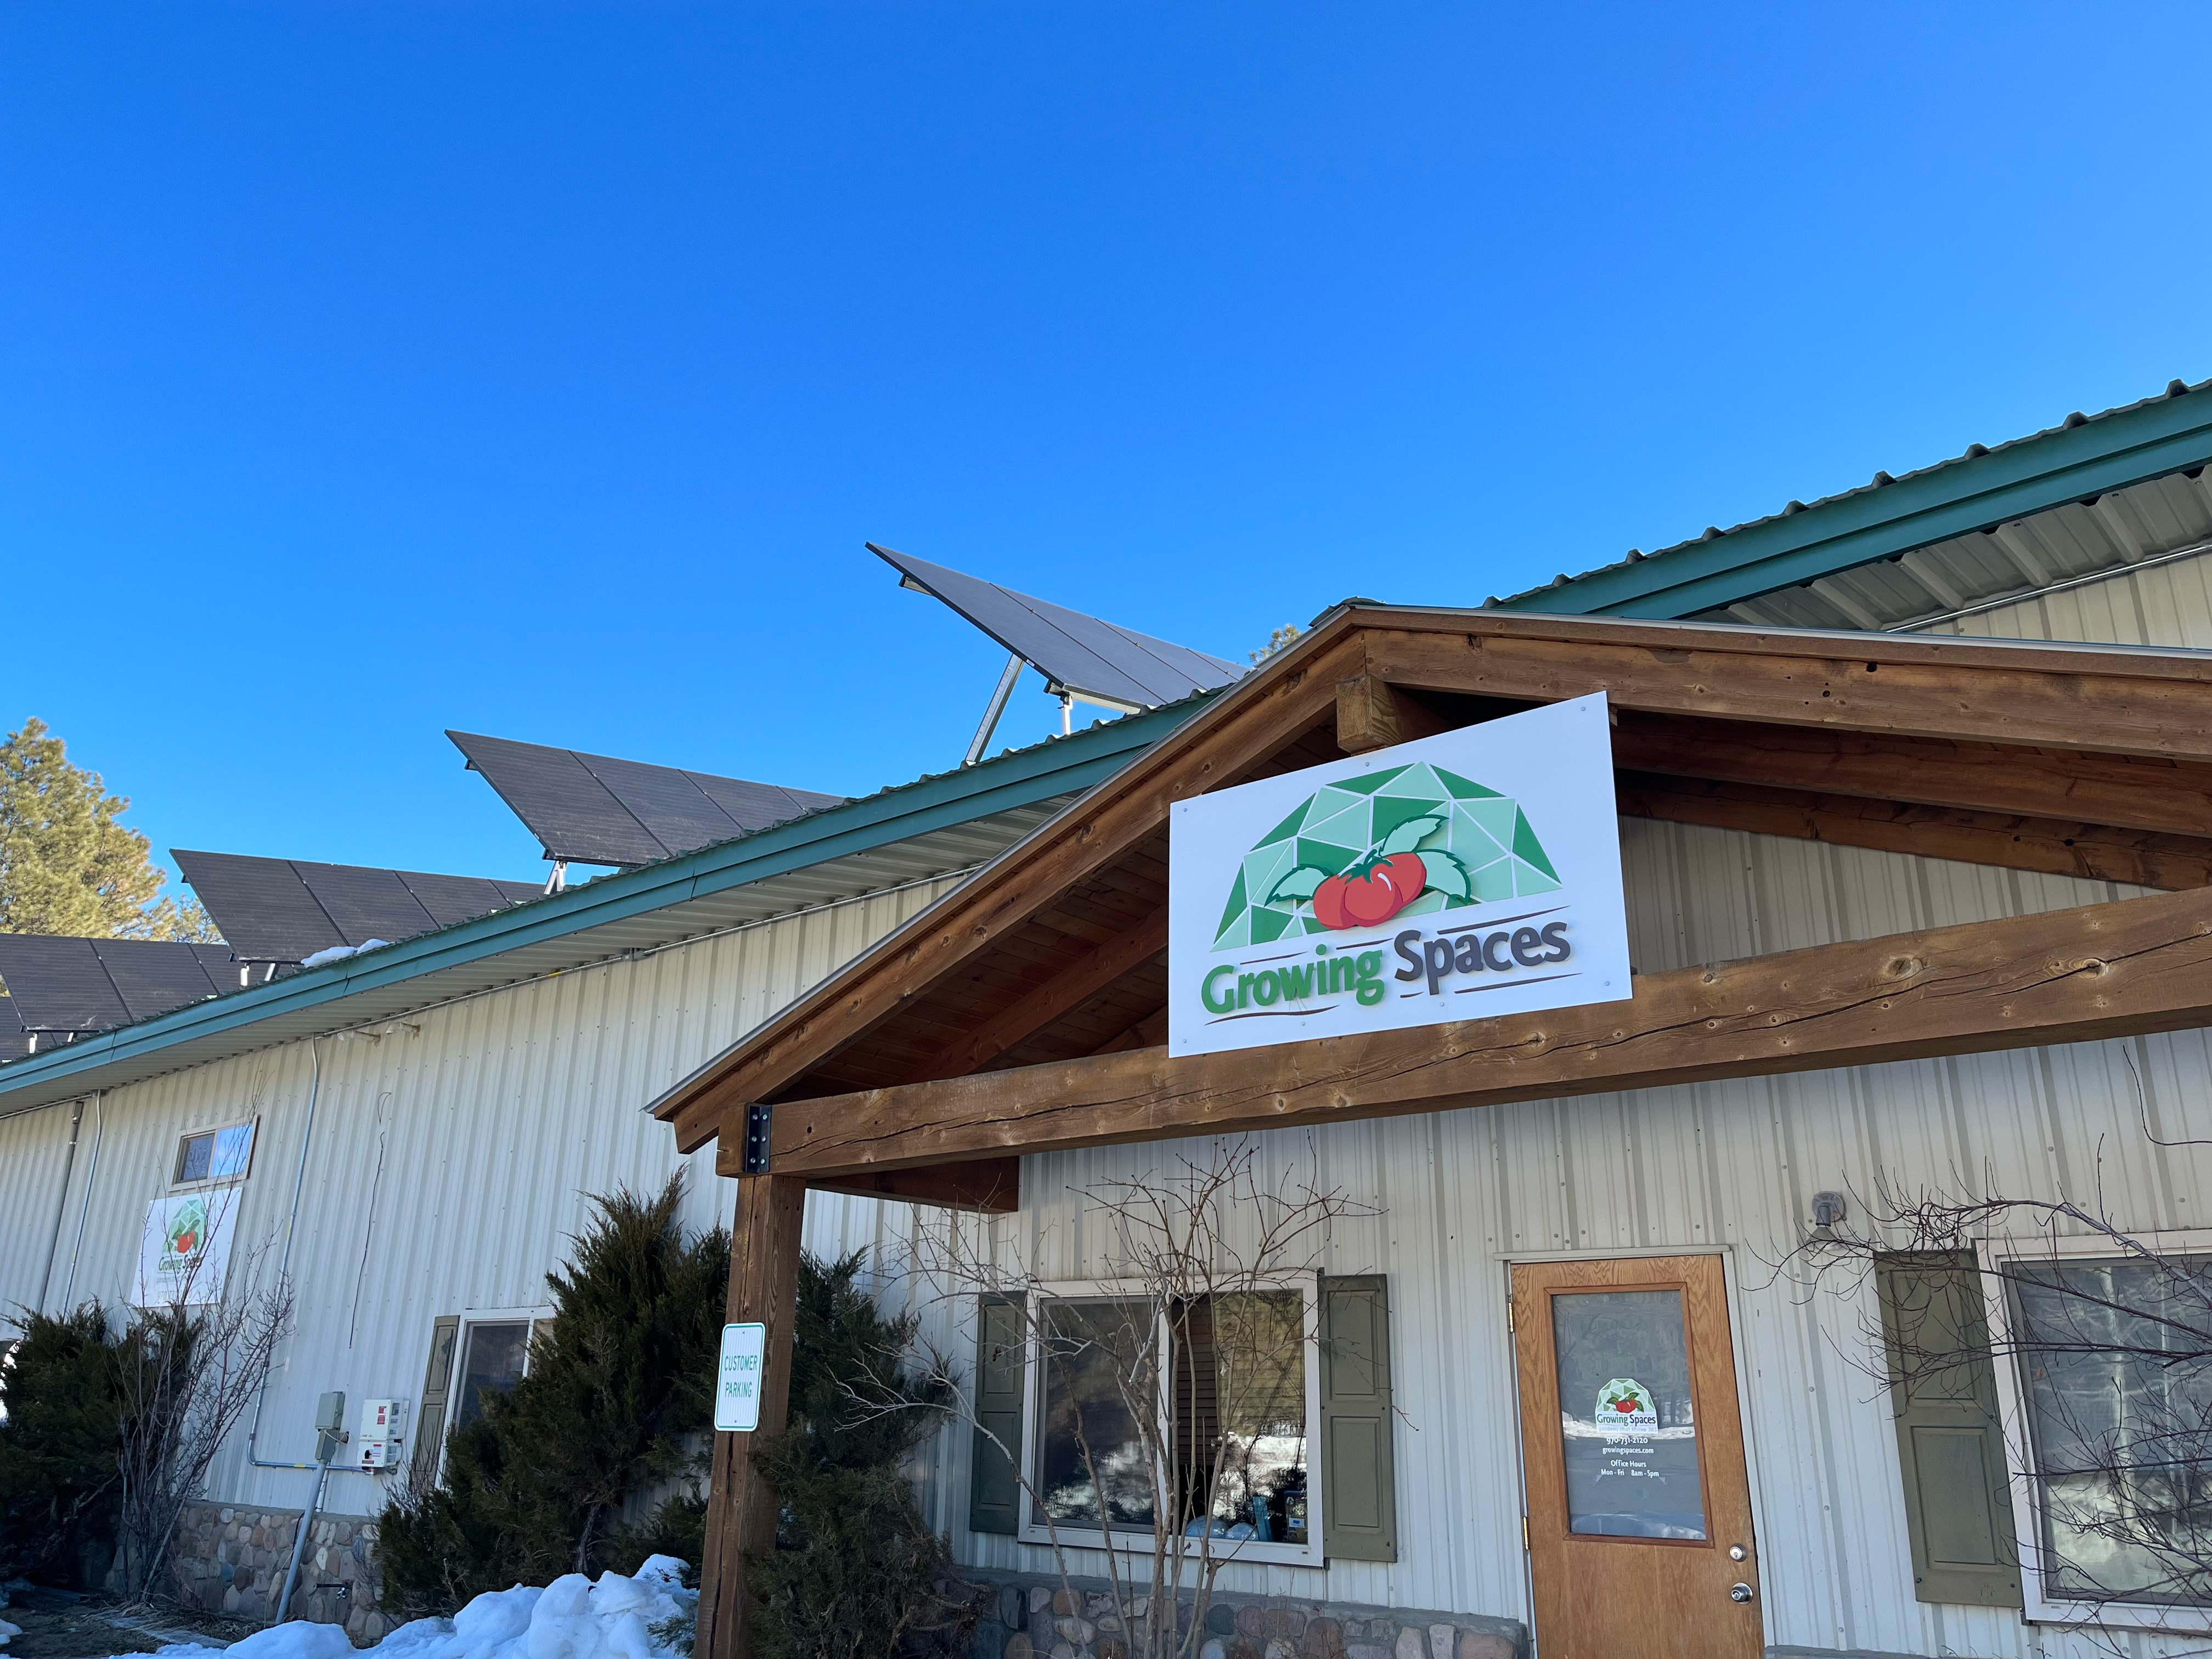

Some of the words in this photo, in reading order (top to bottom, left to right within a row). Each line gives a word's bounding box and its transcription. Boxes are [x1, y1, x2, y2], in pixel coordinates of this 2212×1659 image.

[1201, 944, 1385, 1013] Growing
[1394, 922, 1571, 996] Spaces
[724, 1355, 758, 1371] CUSTOMER
[725, 1382, 752, 1397] PARKING
[1597, 1414, 1628, 1426] Growing
[1629, 1414, 1656, 1426] Spaces
[1602, 1446, 1654, 1455] growingspaces.com
[1647, 1470, 1659, 1479] 5pm
